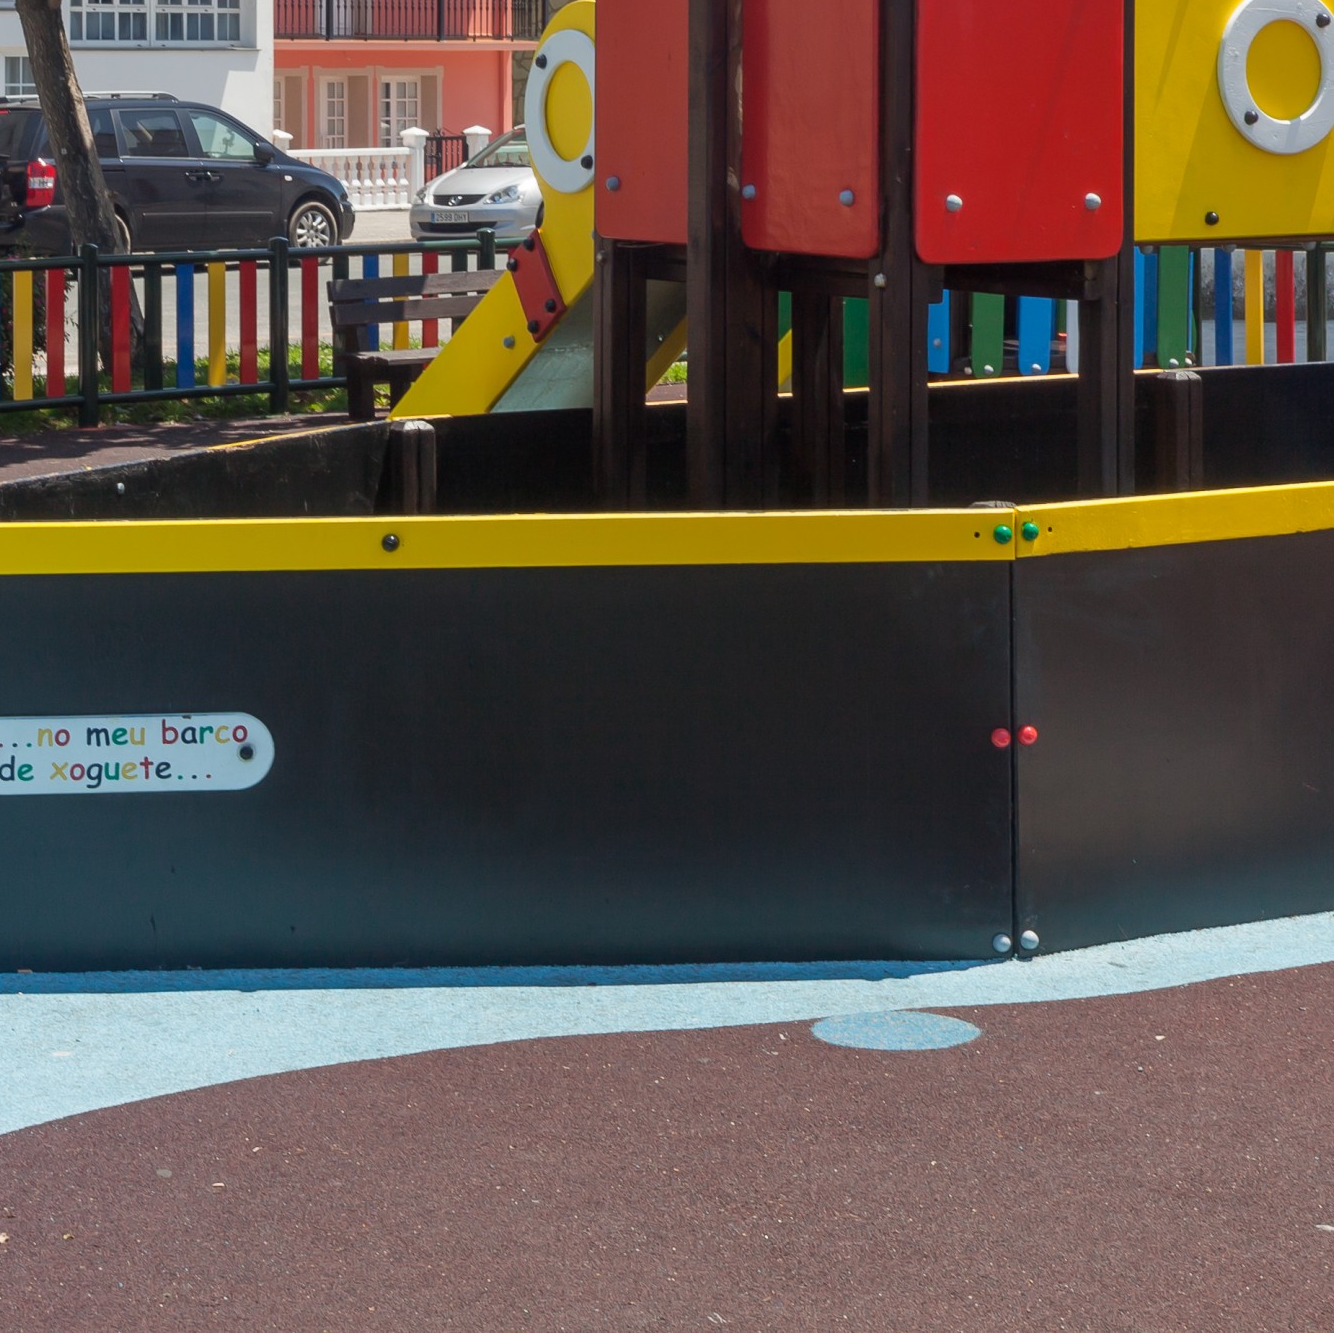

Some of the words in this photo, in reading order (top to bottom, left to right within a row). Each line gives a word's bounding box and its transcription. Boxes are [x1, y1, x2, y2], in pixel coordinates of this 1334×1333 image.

[86, 727, 146, 747] meu
[162, 718, 248, 745] barco
[49, 756, 212, 789] xoguete...
